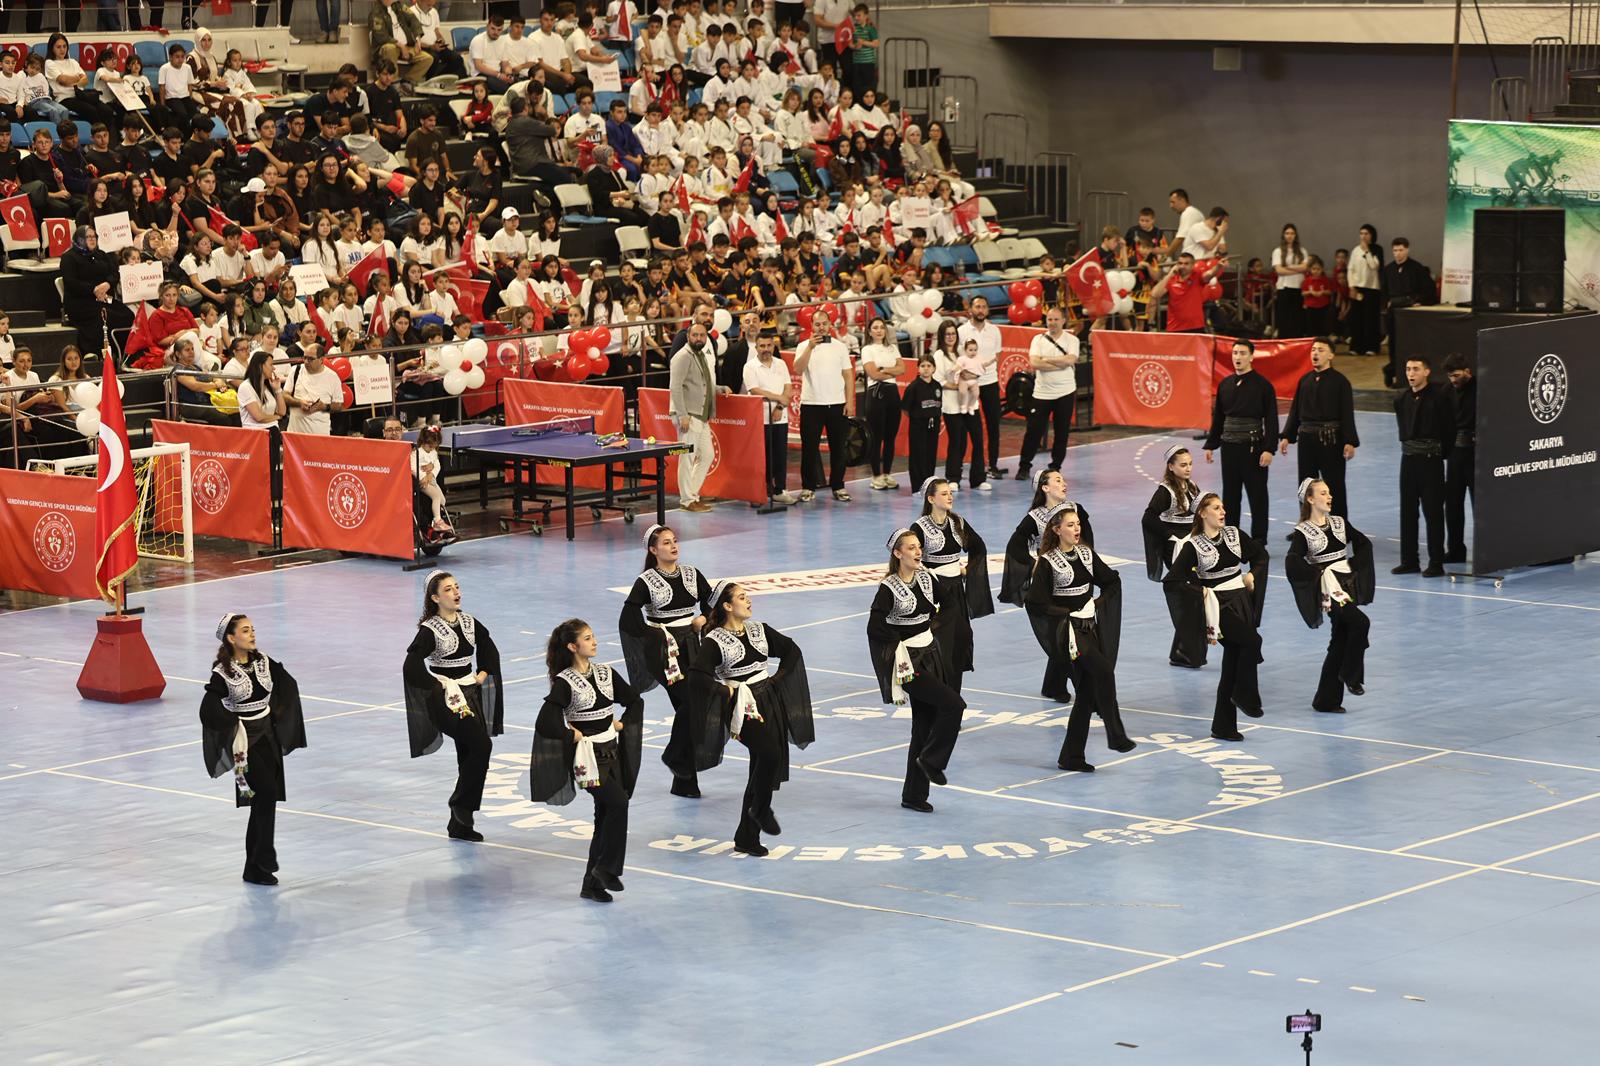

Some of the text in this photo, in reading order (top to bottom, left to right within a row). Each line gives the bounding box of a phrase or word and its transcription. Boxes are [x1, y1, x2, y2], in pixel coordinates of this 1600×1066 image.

[140, 273, 162, 281] SAKARYA
[1529, 436, 1563, 451] SAKARYA
[1493, 450, 1597, 477] GENÇLİK VE SPOR İL MÜDÜRLÜĞÜ
[1130, 732, 1284, 806] SAKARYA
